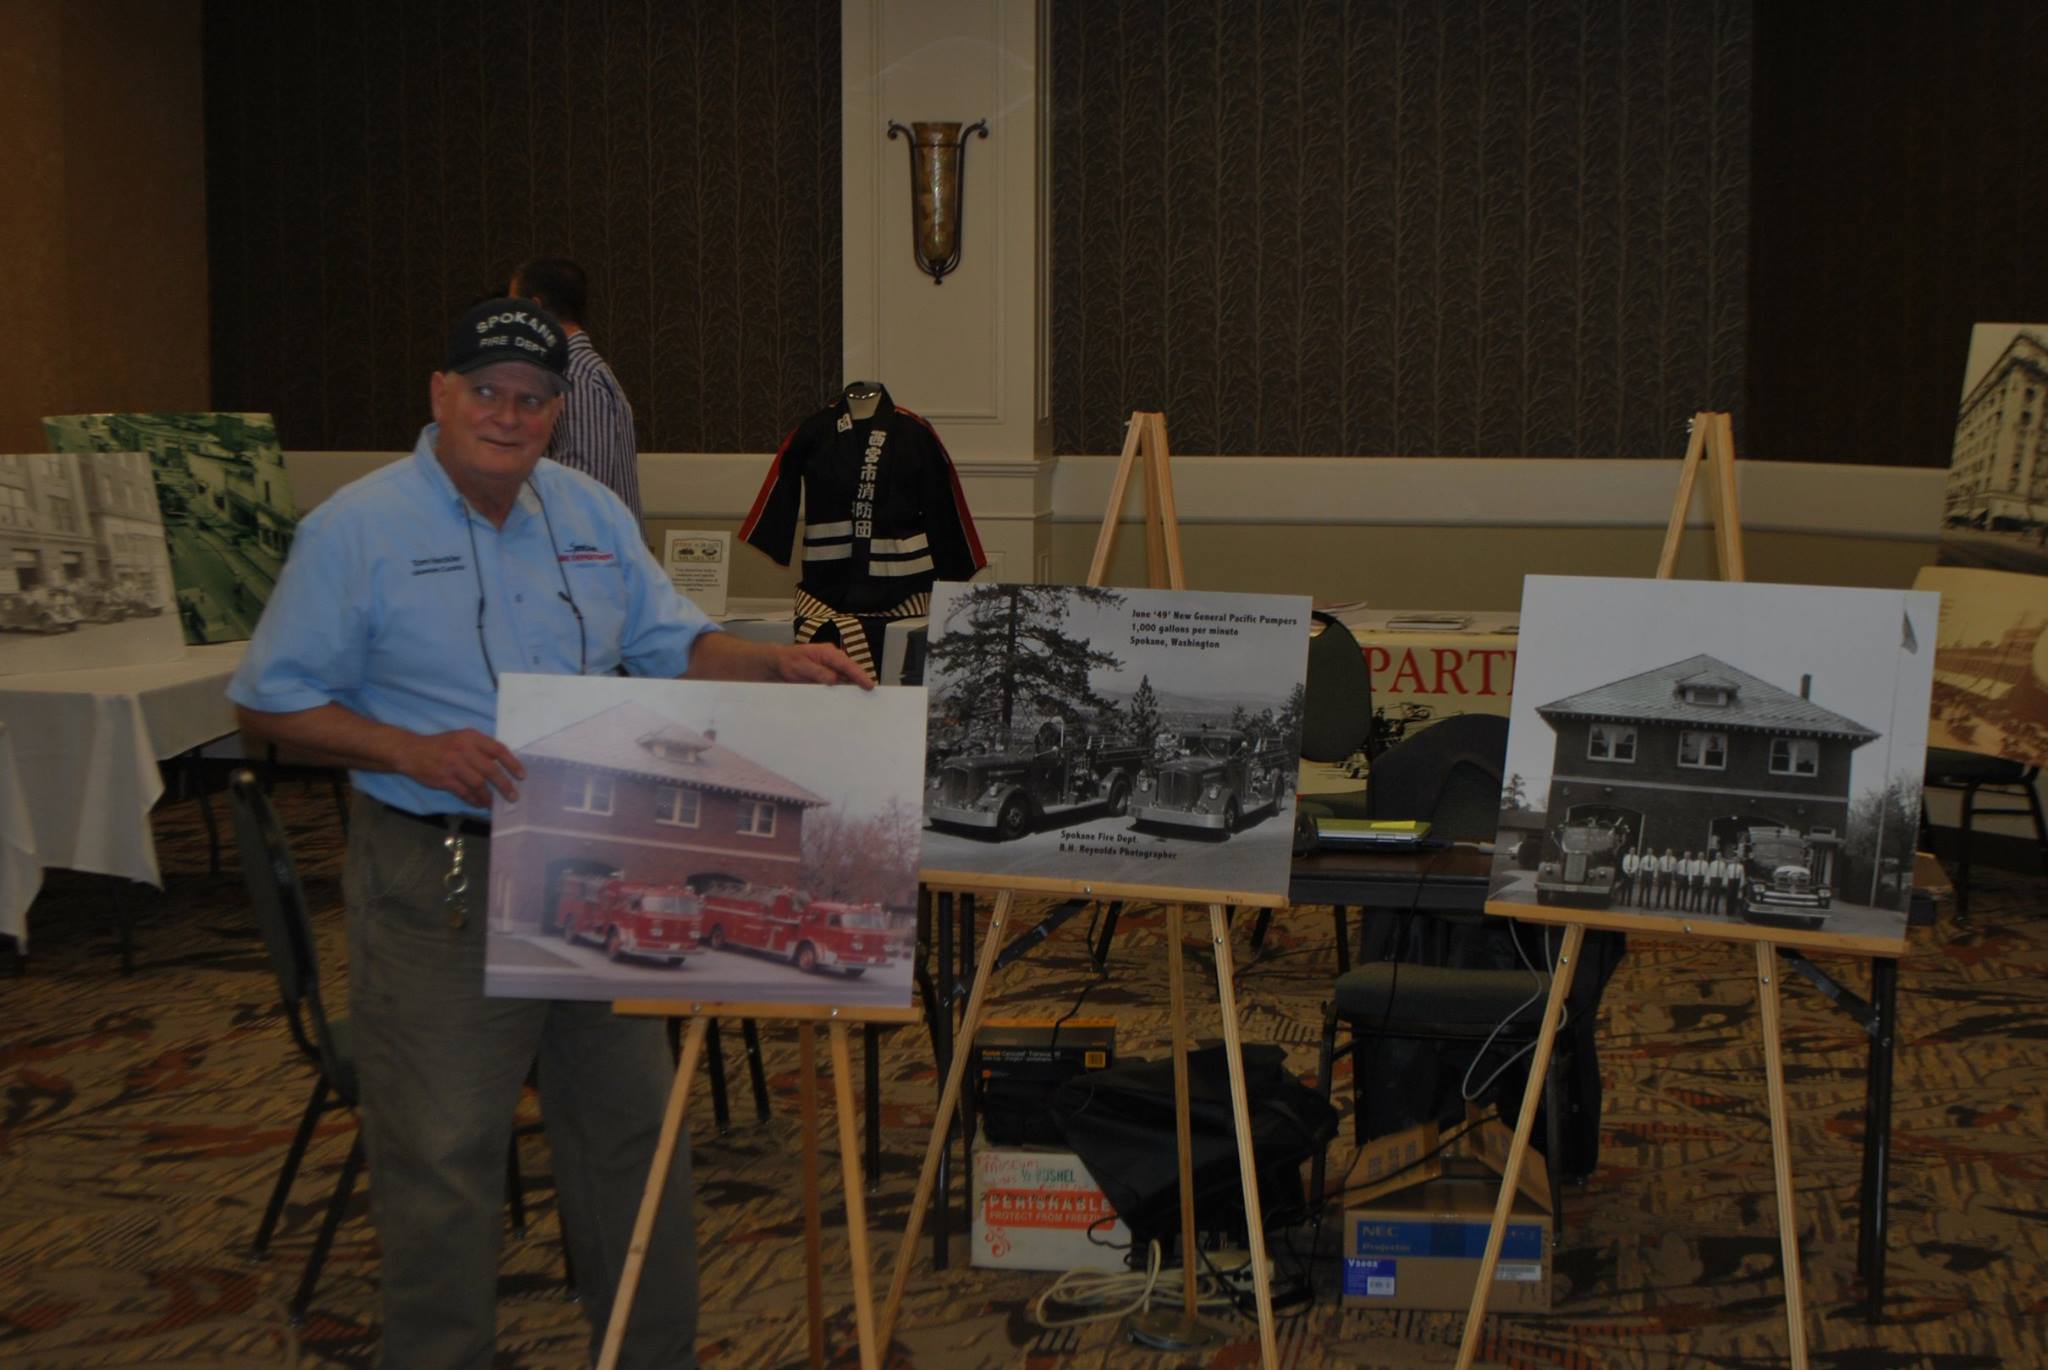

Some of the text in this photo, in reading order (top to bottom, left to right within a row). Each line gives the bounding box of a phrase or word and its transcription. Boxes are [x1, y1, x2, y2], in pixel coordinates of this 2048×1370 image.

[475, 311, 557, 347] SPOKANE
[479, 335, 509, 349] FIRE
[1131, 609, 1151, 619] June
[1173, 611, 1192, 620] New
[1194, 612, 1227, 623] General
[1229, 614, 1257, 624] Pacific
[1259, 615, 1297, 627] Pumpers
[1131, 623, 1239, 637] 1,000 gallons per minute
[1130, 636, 1220, 650] Spokane, Washington
[1060, 830, 1096, 841] Spokane
[1097, 832, 1115, 842] Fire
[1079, 845, 1117, 857] Reynolds
[1119, 847, 1178, 860] Photographer
[989, 1194, 1114, 1213] PERISHABLE
